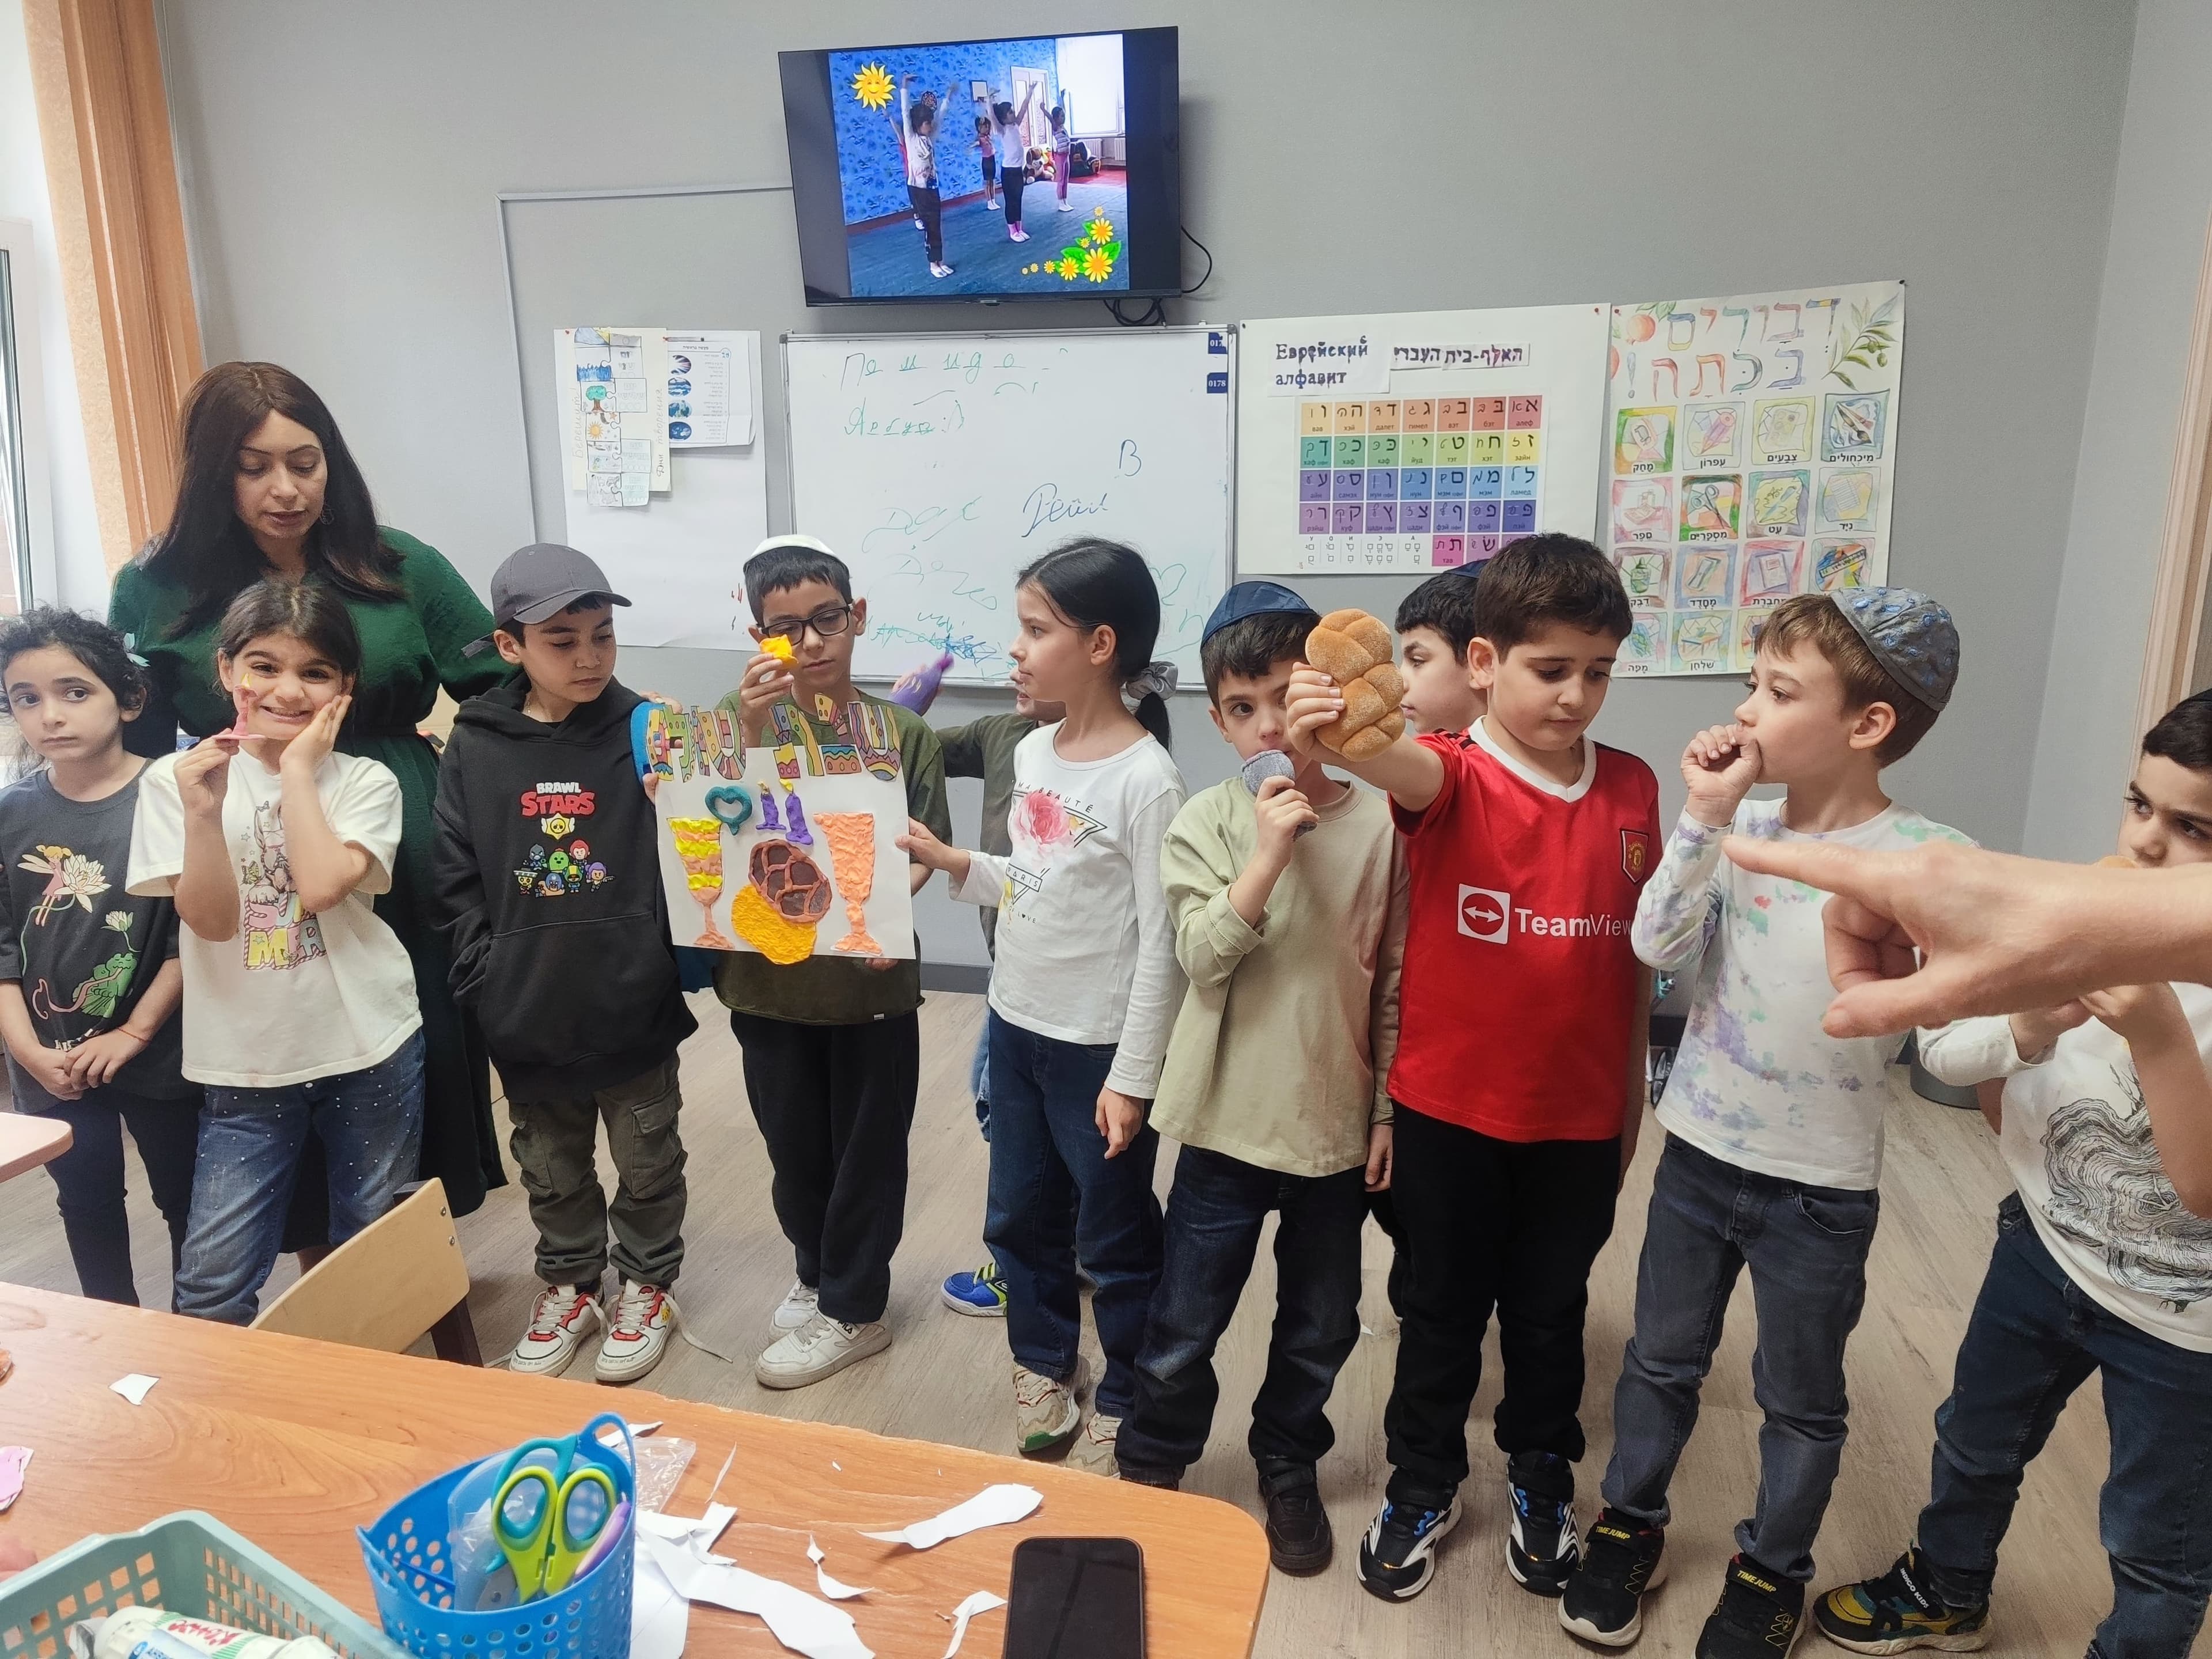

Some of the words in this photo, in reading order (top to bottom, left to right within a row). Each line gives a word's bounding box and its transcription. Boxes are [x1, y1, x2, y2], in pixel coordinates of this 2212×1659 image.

[1276, 336, 1368, 363] Еврейский
[1276, 369, 1347, 388] алфавит
[536, 782, 582, 794] BRAWL
[521, 791, 595, 816] STARS
[1039, 787, 1094, 813] BEAUTÉ
[1914, 1592, 1930, 1609] KIDS
